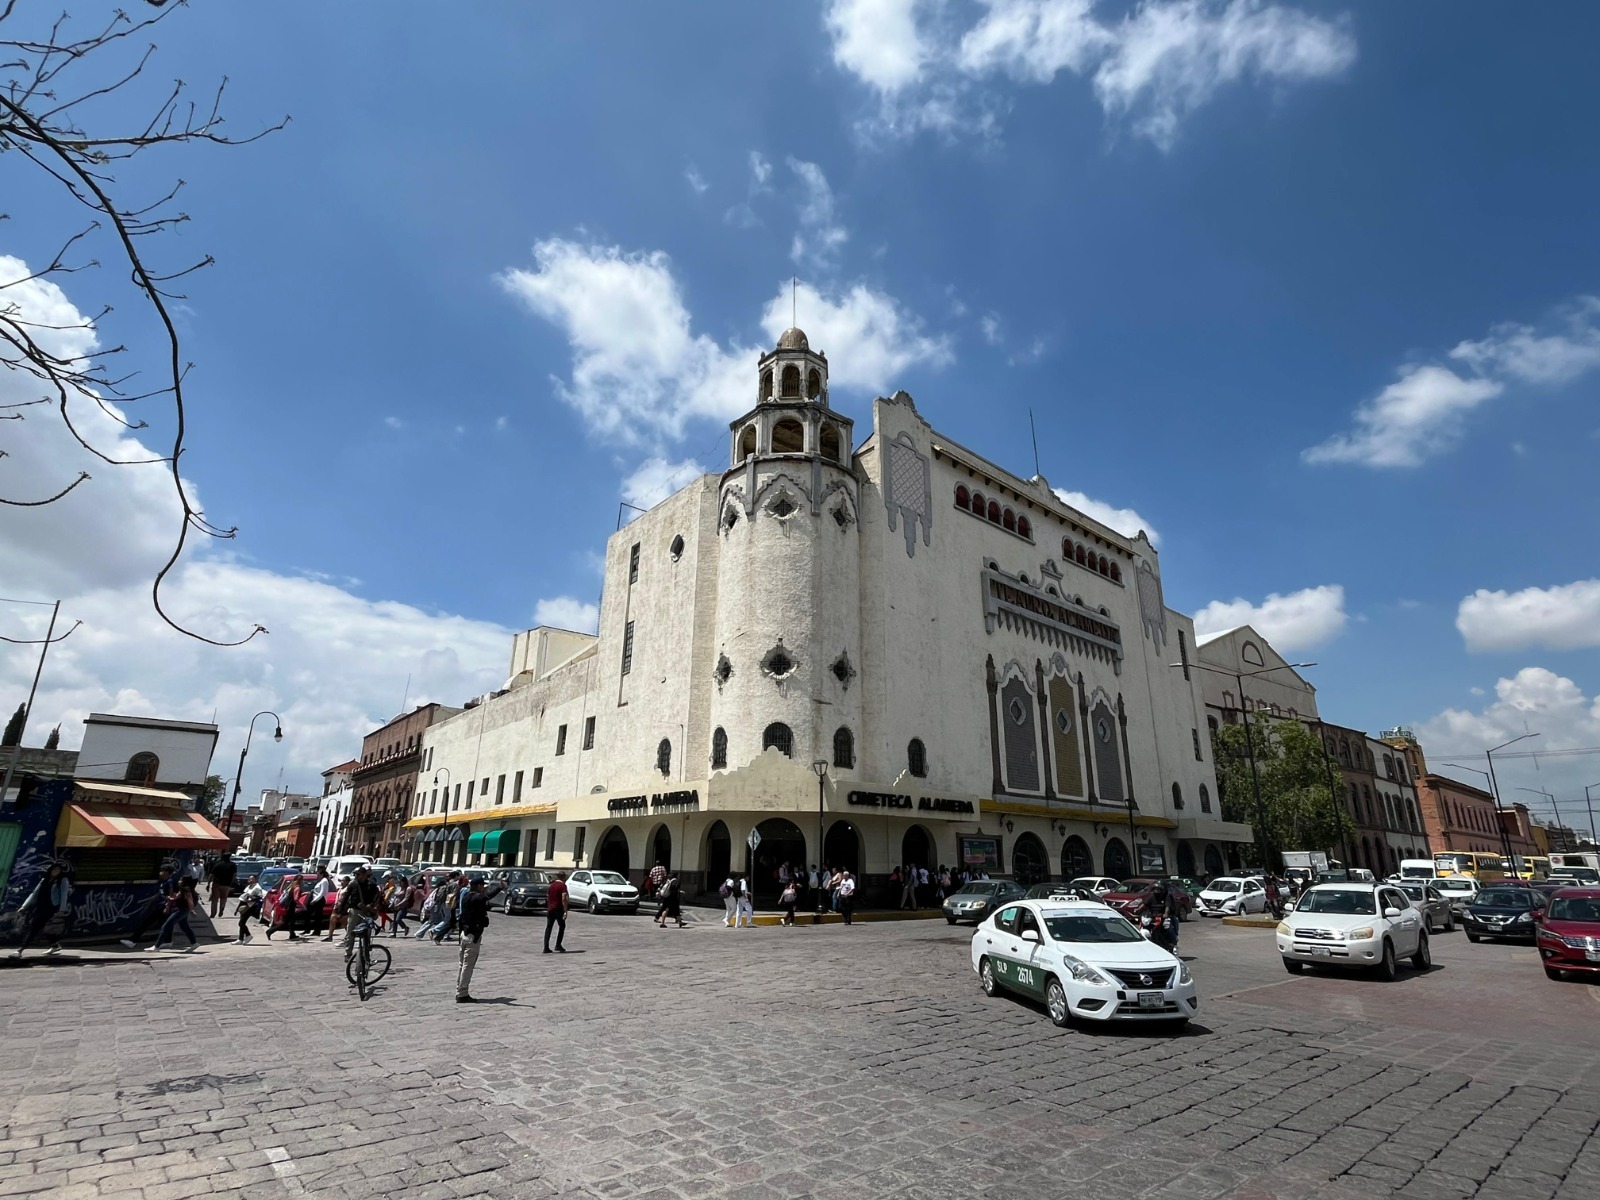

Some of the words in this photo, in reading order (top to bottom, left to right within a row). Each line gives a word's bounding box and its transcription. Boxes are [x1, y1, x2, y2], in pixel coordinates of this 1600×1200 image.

[650, 789, 699, 807] ALAMEDA
[847, 790, 913, 809] CINETECA
[918, 797, 975, 813] ALAMEDA
[997, 960, 1007, 974] SLP
[1017, 966, 1034, 986] 2674
